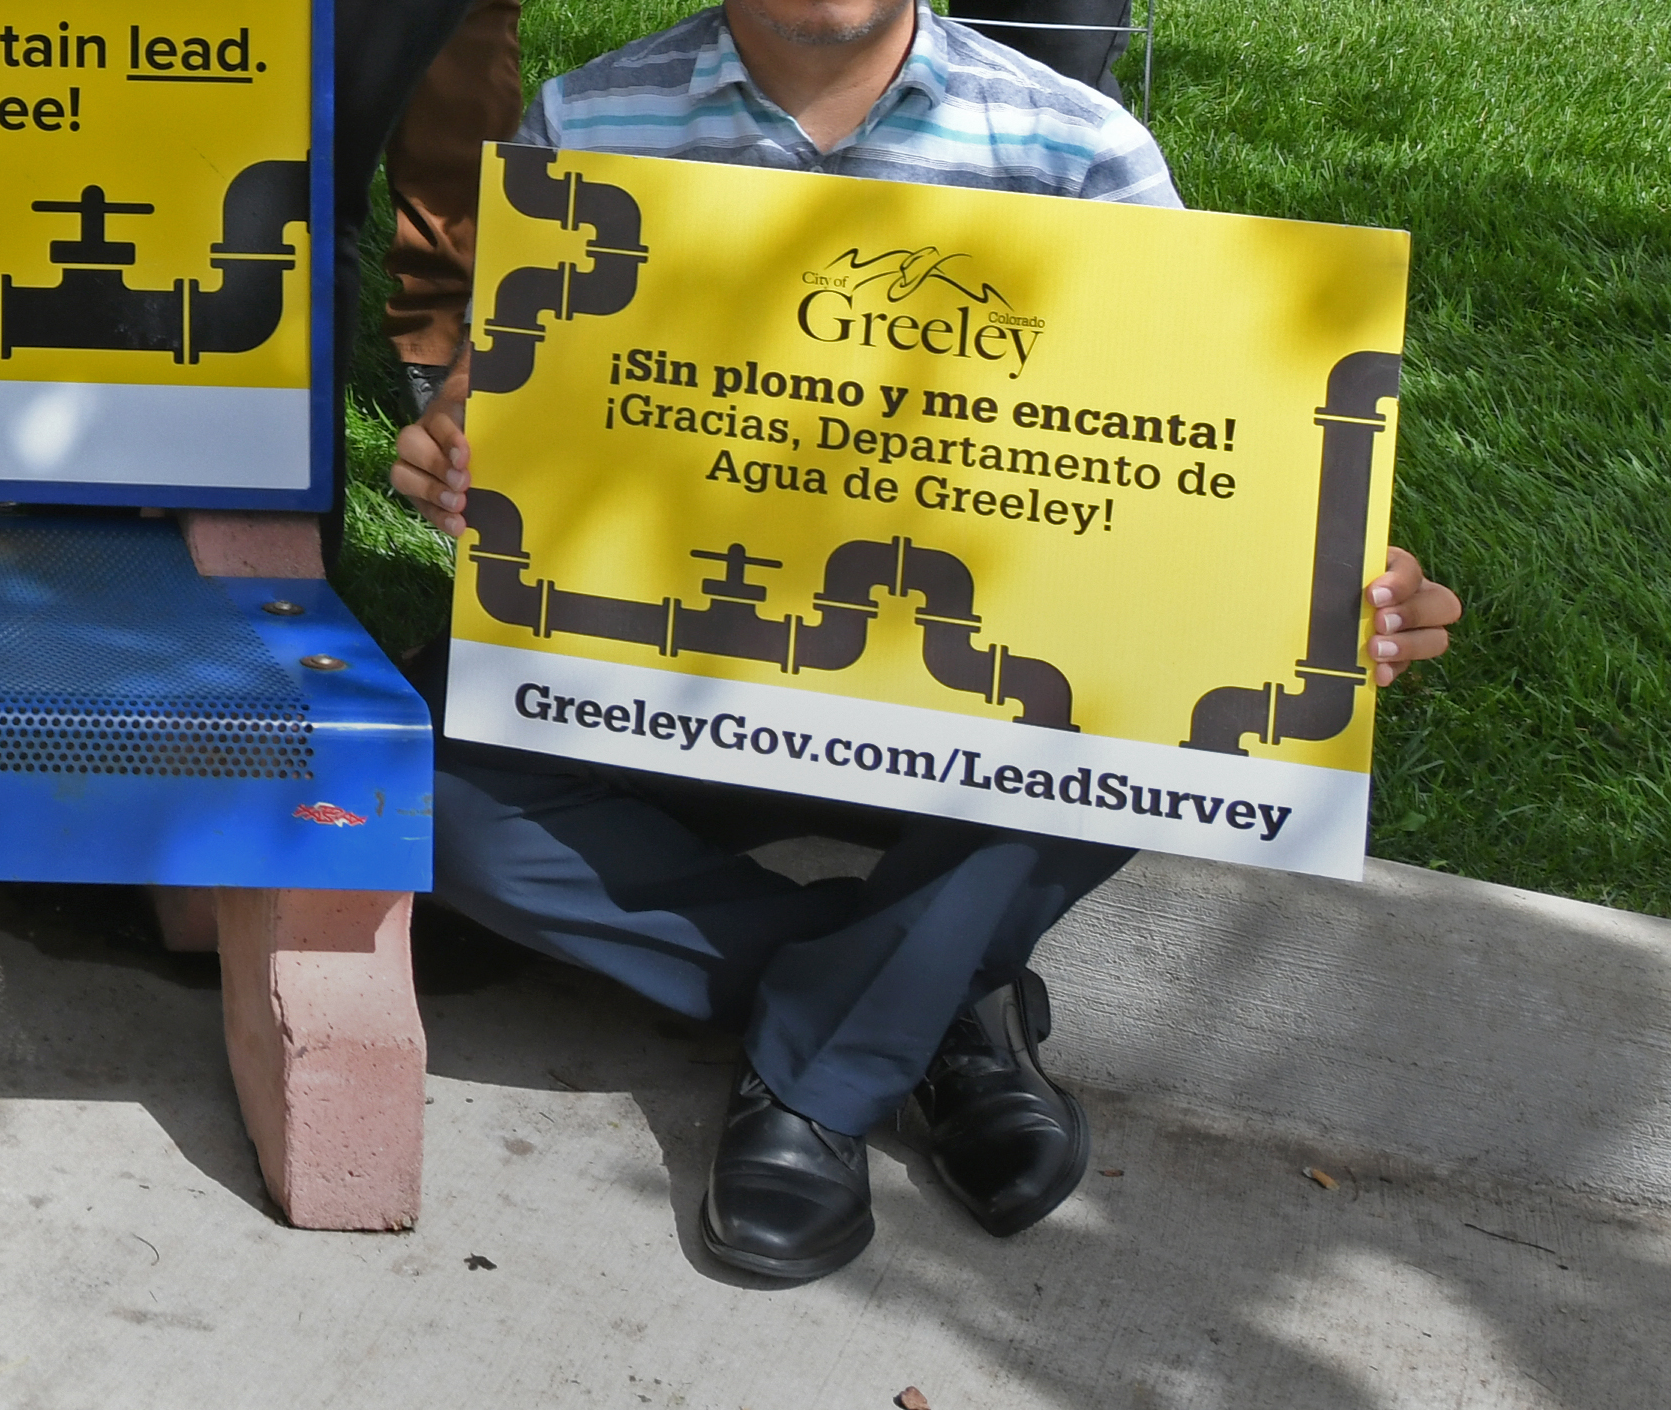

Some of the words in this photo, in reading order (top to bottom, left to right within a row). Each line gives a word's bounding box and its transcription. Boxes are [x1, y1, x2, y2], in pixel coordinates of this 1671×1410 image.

[130, 25, 266, 71] lead.
[797, 289, 1044, 379] Greeley
[605, 396, 799, 450] ¡Gracias,
[816, 417, 1159, 489] Departamento
[1177, 461, 1235, 498] de
[610, 349, 697, 387] ¡Sin
[711, 361, 863, 406] plomo
[880, 385, 908, 418] y
[922, 390, 997, 423] me
[1013, 401, 1235, 451] encanta!
[705, 450, 827, 494] Agua
[843, 467, 898, 502] de
[914, 475, 1113, 534] Greeley!
[515, 682, 1291, 841] GreeleyGov.com/LeadSurvey
